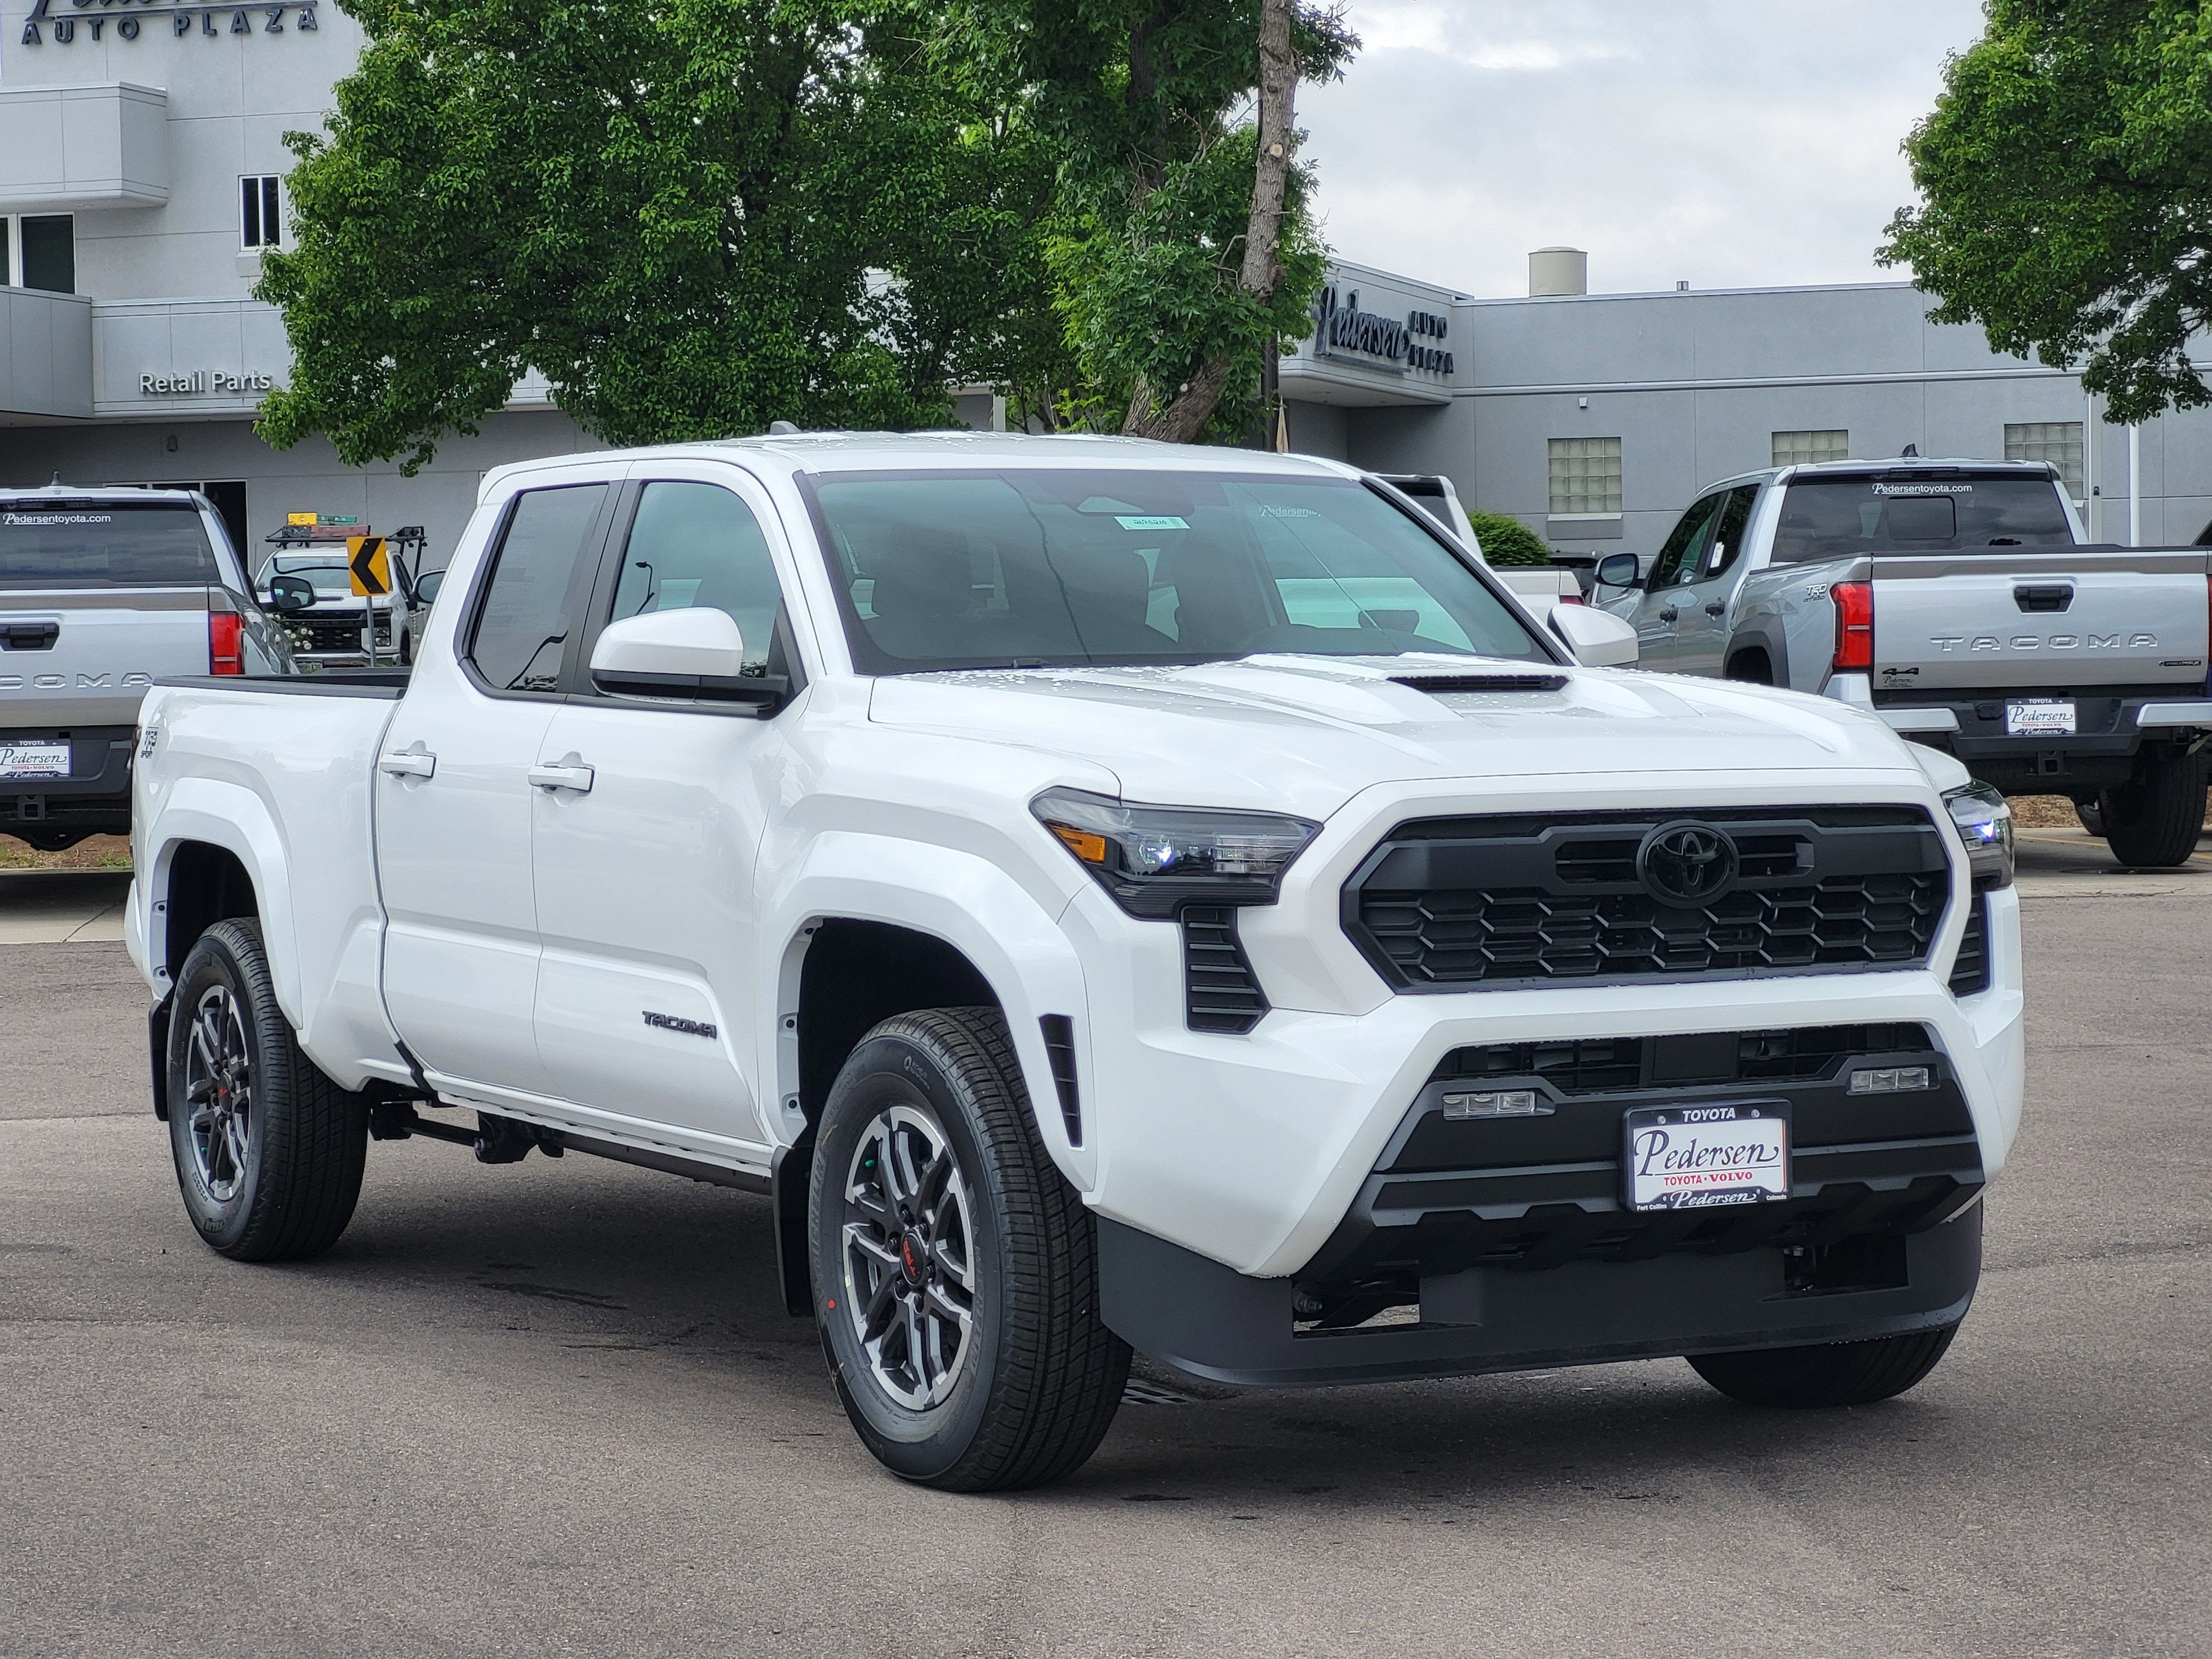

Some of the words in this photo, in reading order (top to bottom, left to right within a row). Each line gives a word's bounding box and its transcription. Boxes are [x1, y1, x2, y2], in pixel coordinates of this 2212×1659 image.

[21, 16, 139, 45] AUTO
[173, 7, 318, 36] PLAZA
[1312, 281, 1411, 358] Pedersen
[1408, 310, 1448, 338] AUTO
[1408, 344, 1453, 373] PLAZA
[139, 371, 205, 393] Retail
[211, 370, 272, 391] Parts
[1872, 483, 1973, 494] Pedersentoyota.com
[3, 513, 111, 525] Pedersentoyota.com
[1930, 633, 2158, 651] TACOMA
[2009, 706, 2073, 723] Pedersen
[0, 748, 67, 765] Pedersen
[642, 1010, 717, 1040] TACOMA
[1682, 1108, 1736, 1123] TOYOTA
[1634, 1130, 1779, 1177] Pedersen
[1664, 1175, 1703, 1186] TOYOTA
[1708, 1171, 1754, 1182] VOLVO
[1670, 1189, 1757, 1209] Pedersen
